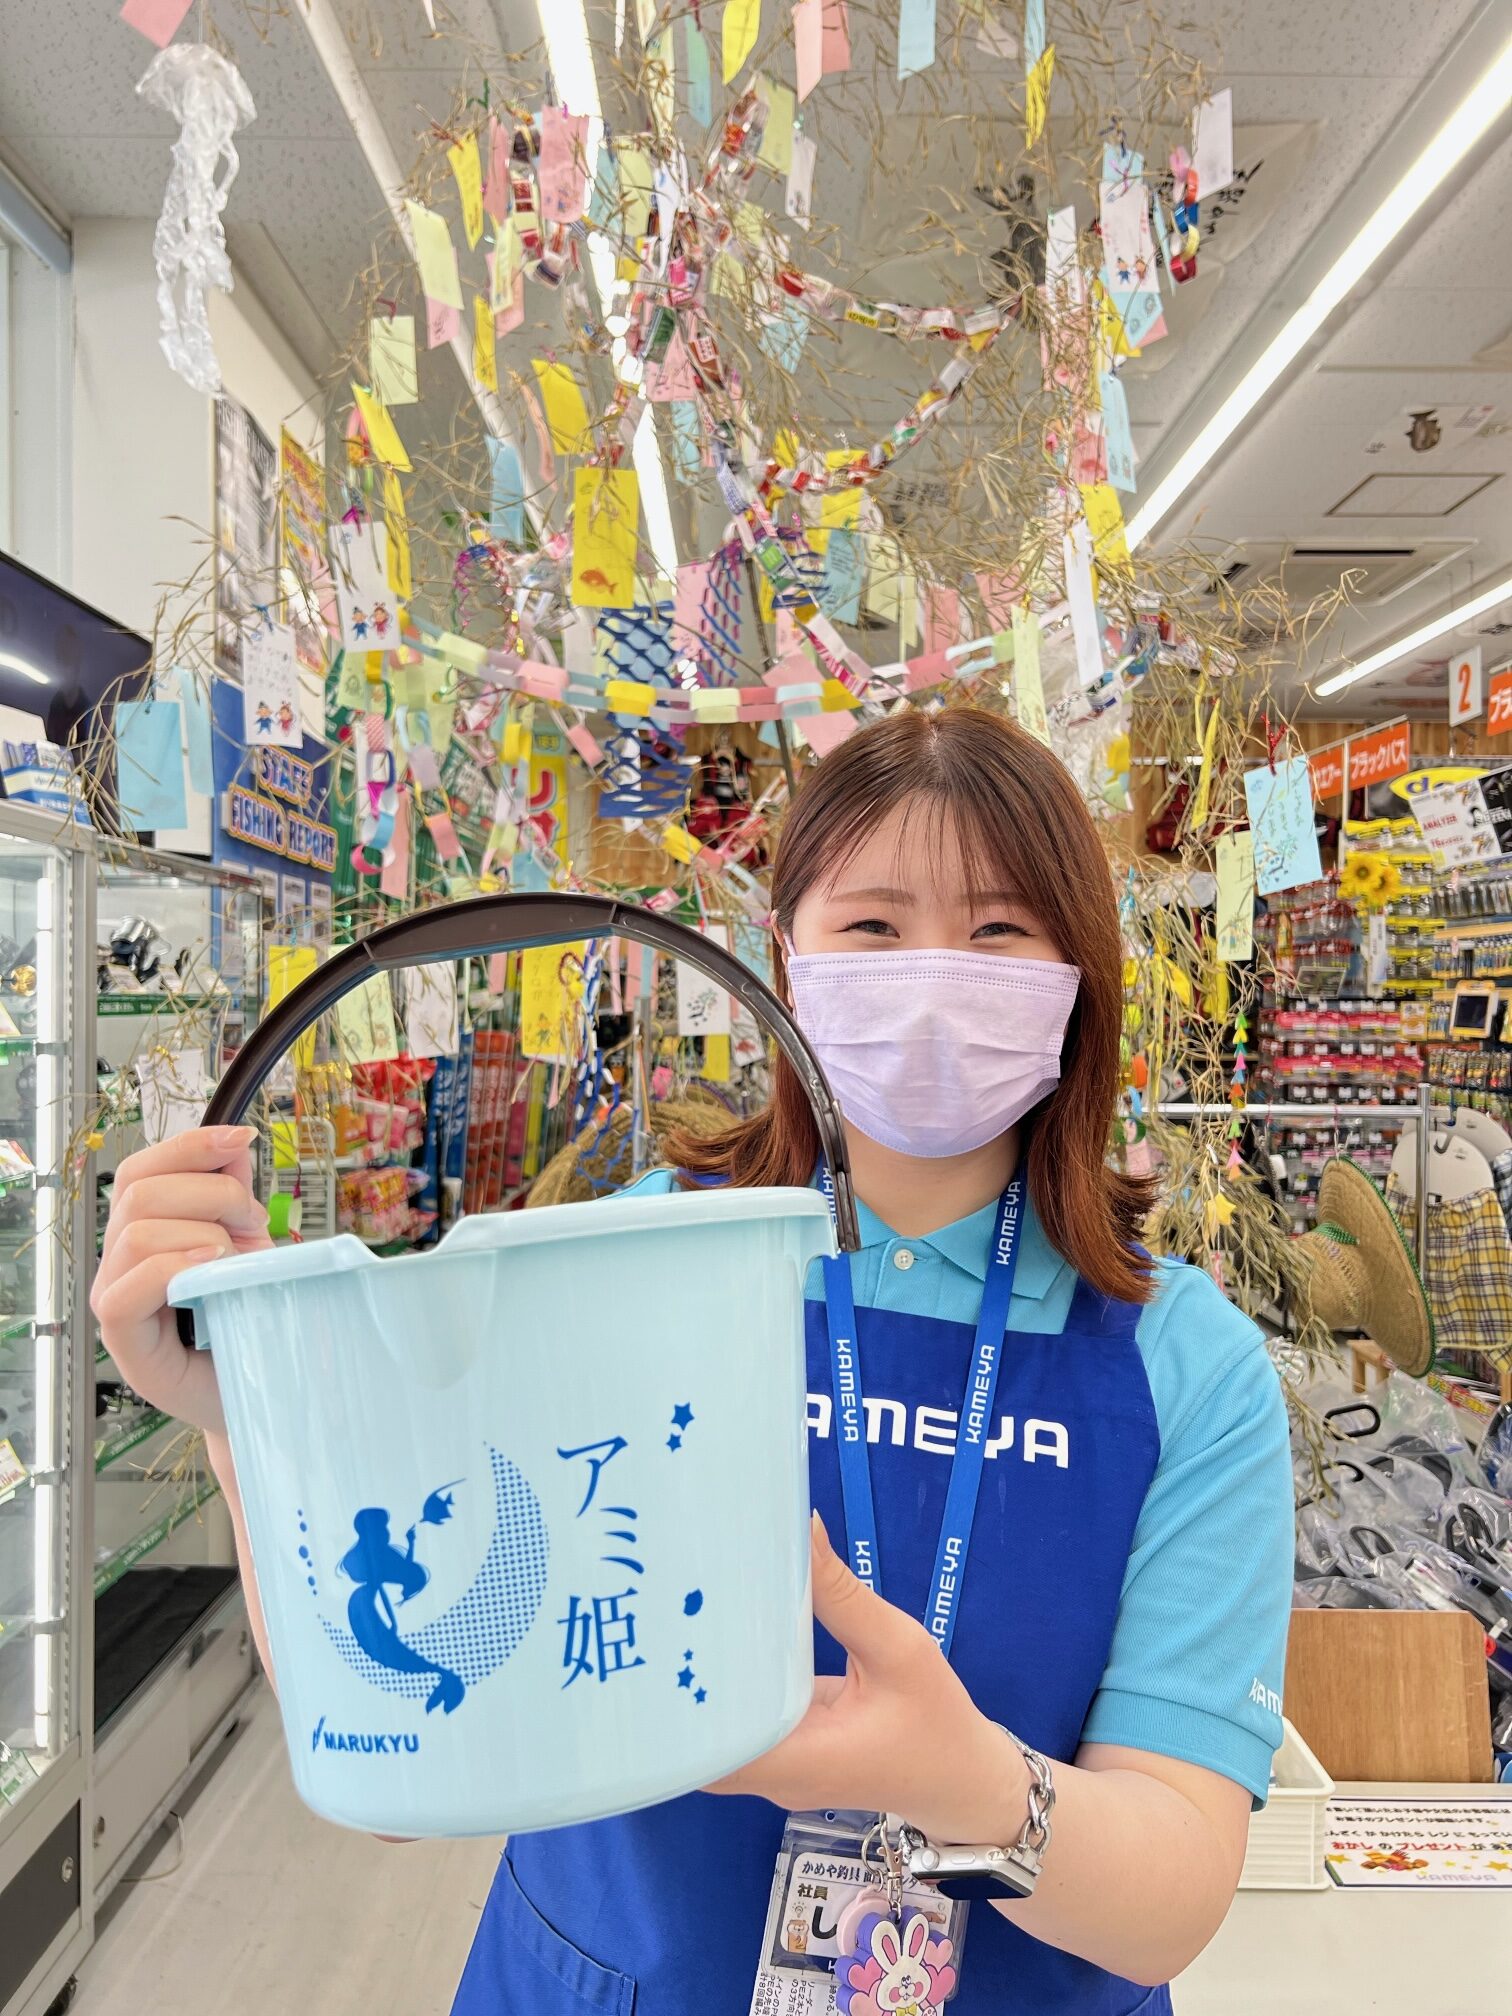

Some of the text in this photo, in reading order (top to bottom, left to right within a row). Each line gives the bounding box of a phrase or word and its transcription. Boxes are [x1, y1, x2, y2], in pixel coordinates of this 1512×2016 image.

[1457, 662, 1473, 714] 2
[1349, 738, 1407, 780] ブラックバス
[231, 790, 336, 866] FISHING REPORT
[995, 1180, 1022, 1266] KAMEYA
[836, 1338, 861, 1443] KAMEYA
[966, 1344, 996, 1444] KAMEYA
[806, 1393, 1071, 1469] AMEYA
[556, 1435, 647, 1691] アミ姫
[1248, 1676, 1283, 1717] KAM
[323, 1731, 420, 1754] MARUKYU
[801, 1860, 861, 1881] かめや釣具
[1332, 1841, 1373, 1851] おかし
[1379, 1842, 1393, 1851] の
[1396, 1842, 1466, 1852] プレゼント
[797, 1883, 829, 1901] 社員
